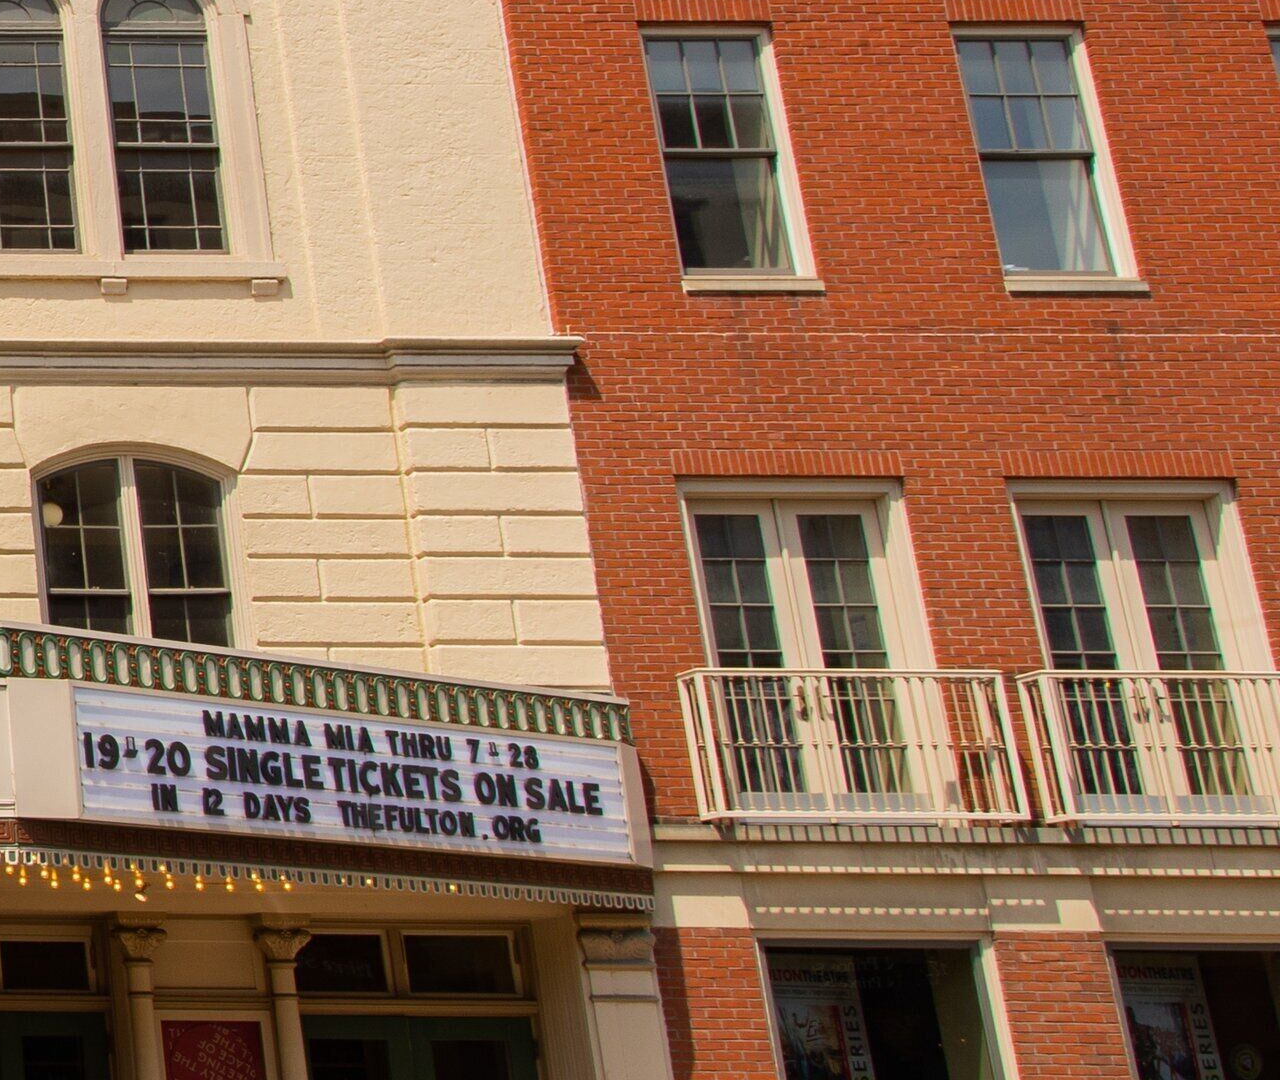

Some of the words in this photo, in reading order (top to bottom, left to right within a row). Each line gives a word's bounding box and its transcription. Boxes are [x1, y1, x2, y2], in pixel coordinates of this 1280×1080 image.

[202, 709, 313, 747] MAMMA
[323, 723, 376, 753] MIA
[384, 730, 453, 761] THRU
[151, 783, 180, 812] IN
[202, 787, 225, 816] 12
[243, 791, 312, 823] DAYS
[204, 745, 325, 790] SINGLE
[327, 757, 463, 803] TICKETS
[474, 771, 519, 808] ON
[524, 777, 604, 816] SALE
